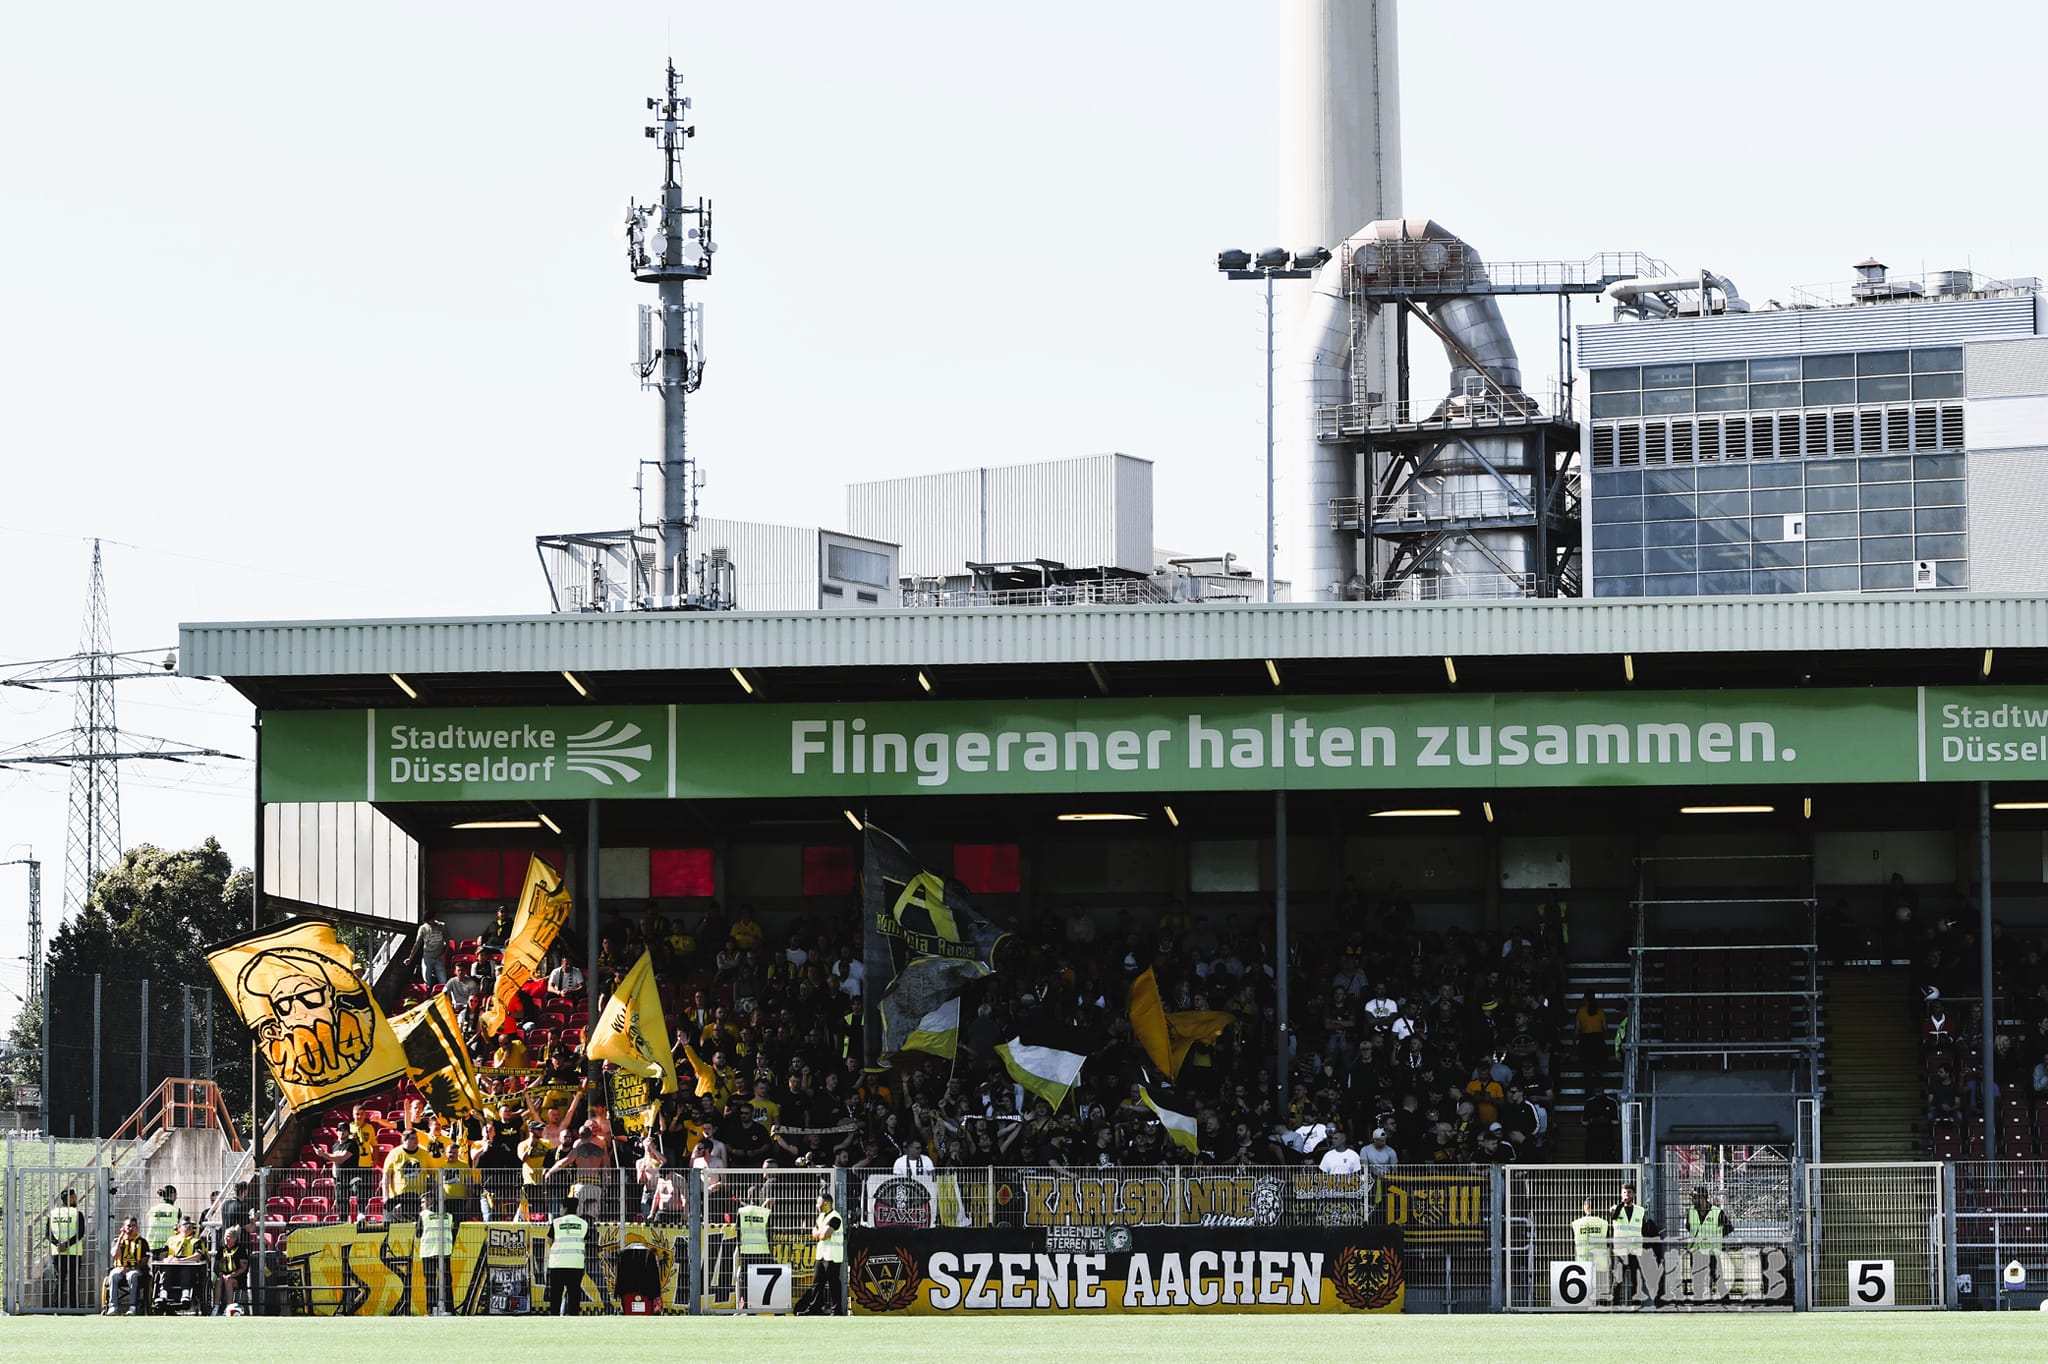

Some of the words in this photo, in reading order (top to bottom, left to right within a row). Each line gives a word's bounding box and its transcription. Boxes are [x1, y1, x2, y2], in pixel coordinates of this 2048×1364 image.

[391, 724, 556, 750] Stadtwerke
[791, 718, 1172, 787] Flingeraner
[1188, 713, 1397, 770] halten
[1416, 721, 1797, 767] zusammen.
[1942, 735, 2047, 763] Düssel
[391, 754, 556, 783] Düsseldorf
[269, 1008, 364, 1081] 2014
[878, 1207, 927, 1224] FAXE
[1024, 1177, 1256, 1227] KARLSBANDE
[1047, 1226, 1106, 1239] LEGENDEN
[1200, 1213, 1255, 1229] Ultras
[1046, 1237, 1087, 1250] STERBEN
[757, 1268, 782, 1305] 7
[928, 1251, 1107, 1310] SZENE
[1123, 1252, 1324, 1308] AACHEN
[1558, 1265, 1587, 1305] 6
[1857, 1263, 1886, 1303] 5
